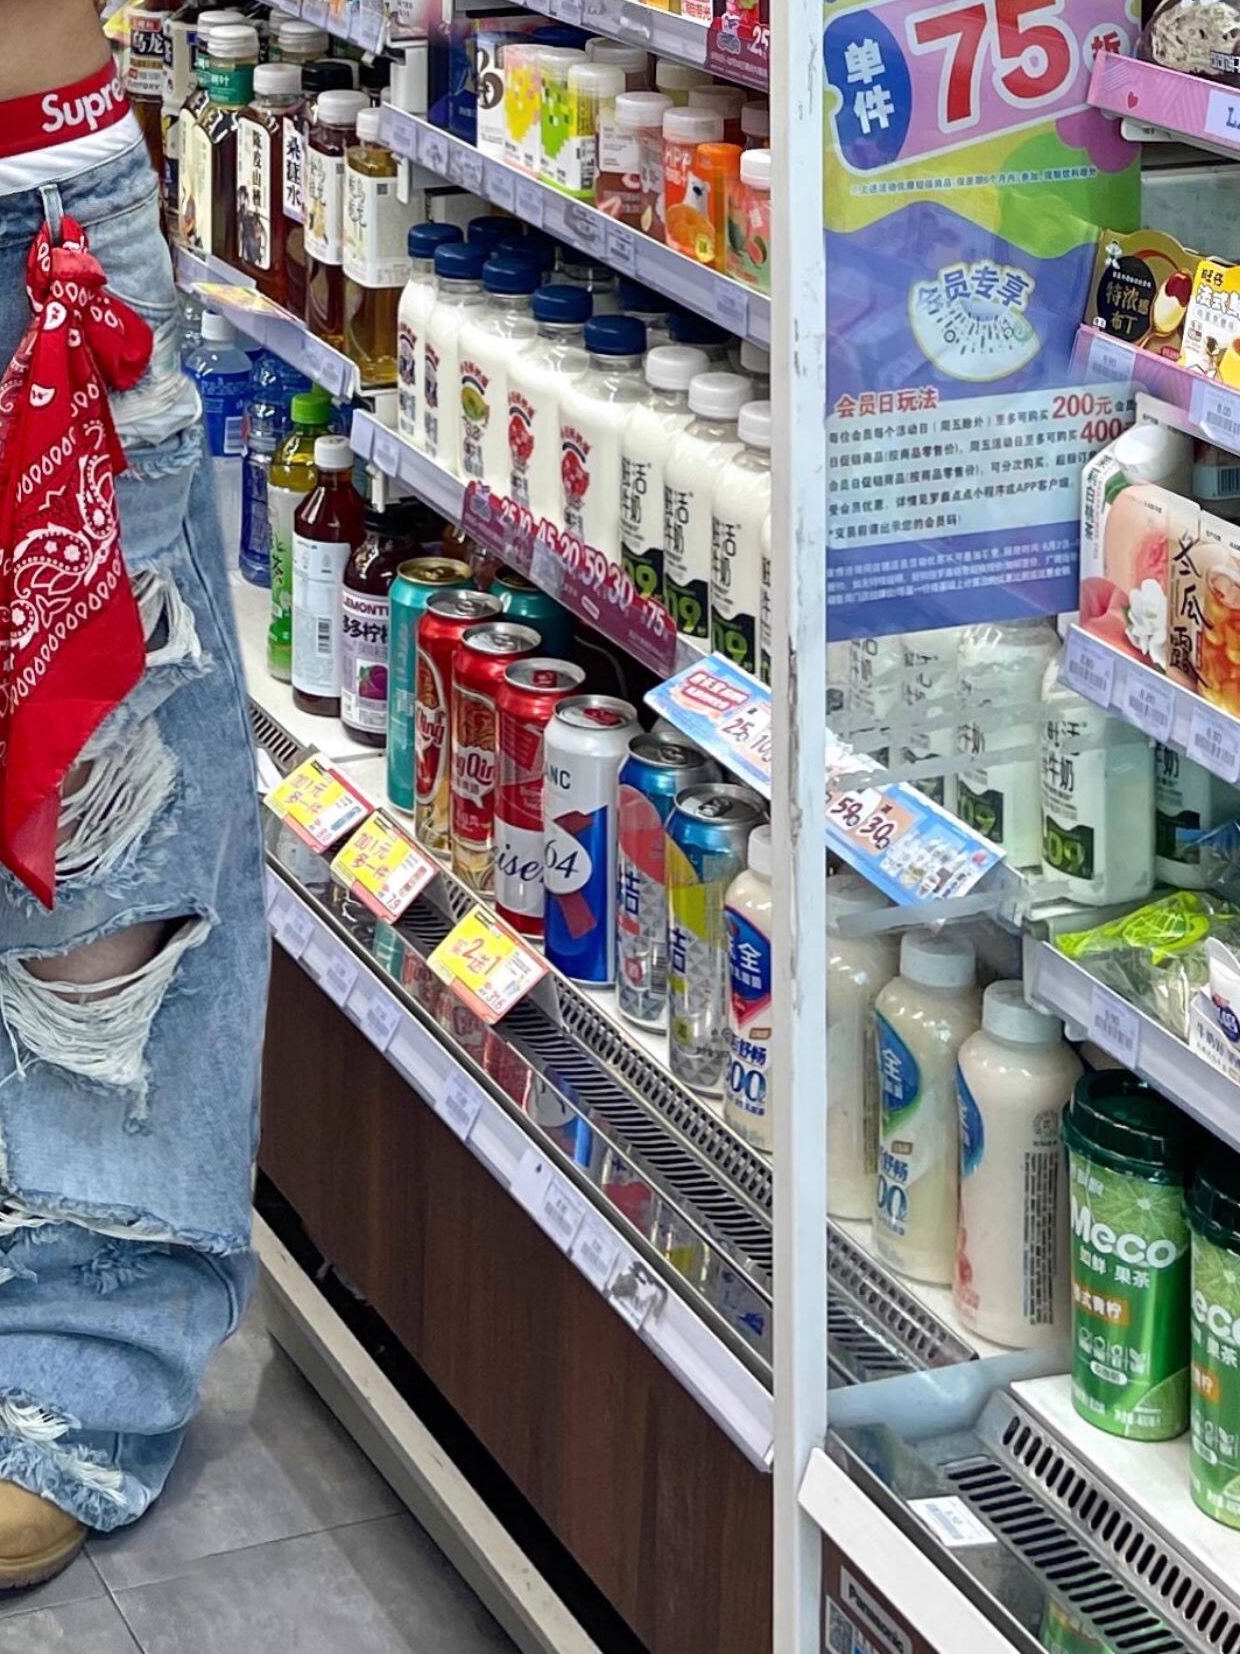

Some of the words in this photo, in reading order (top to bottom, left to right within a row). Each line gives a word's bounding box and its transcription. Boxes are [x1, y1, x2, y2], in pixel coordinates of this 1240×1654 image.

[844, 38, 895, 134] 单件
[919, 266, 1029, 312] 会员专享
[835, 388, 939, 418] 会员日玩法
[1070, 1196, 1177, 1269] Meco
[1114, 1264, 1151, 1290] 果茶
[1206, 1343, 1238, 1369] 果茶
